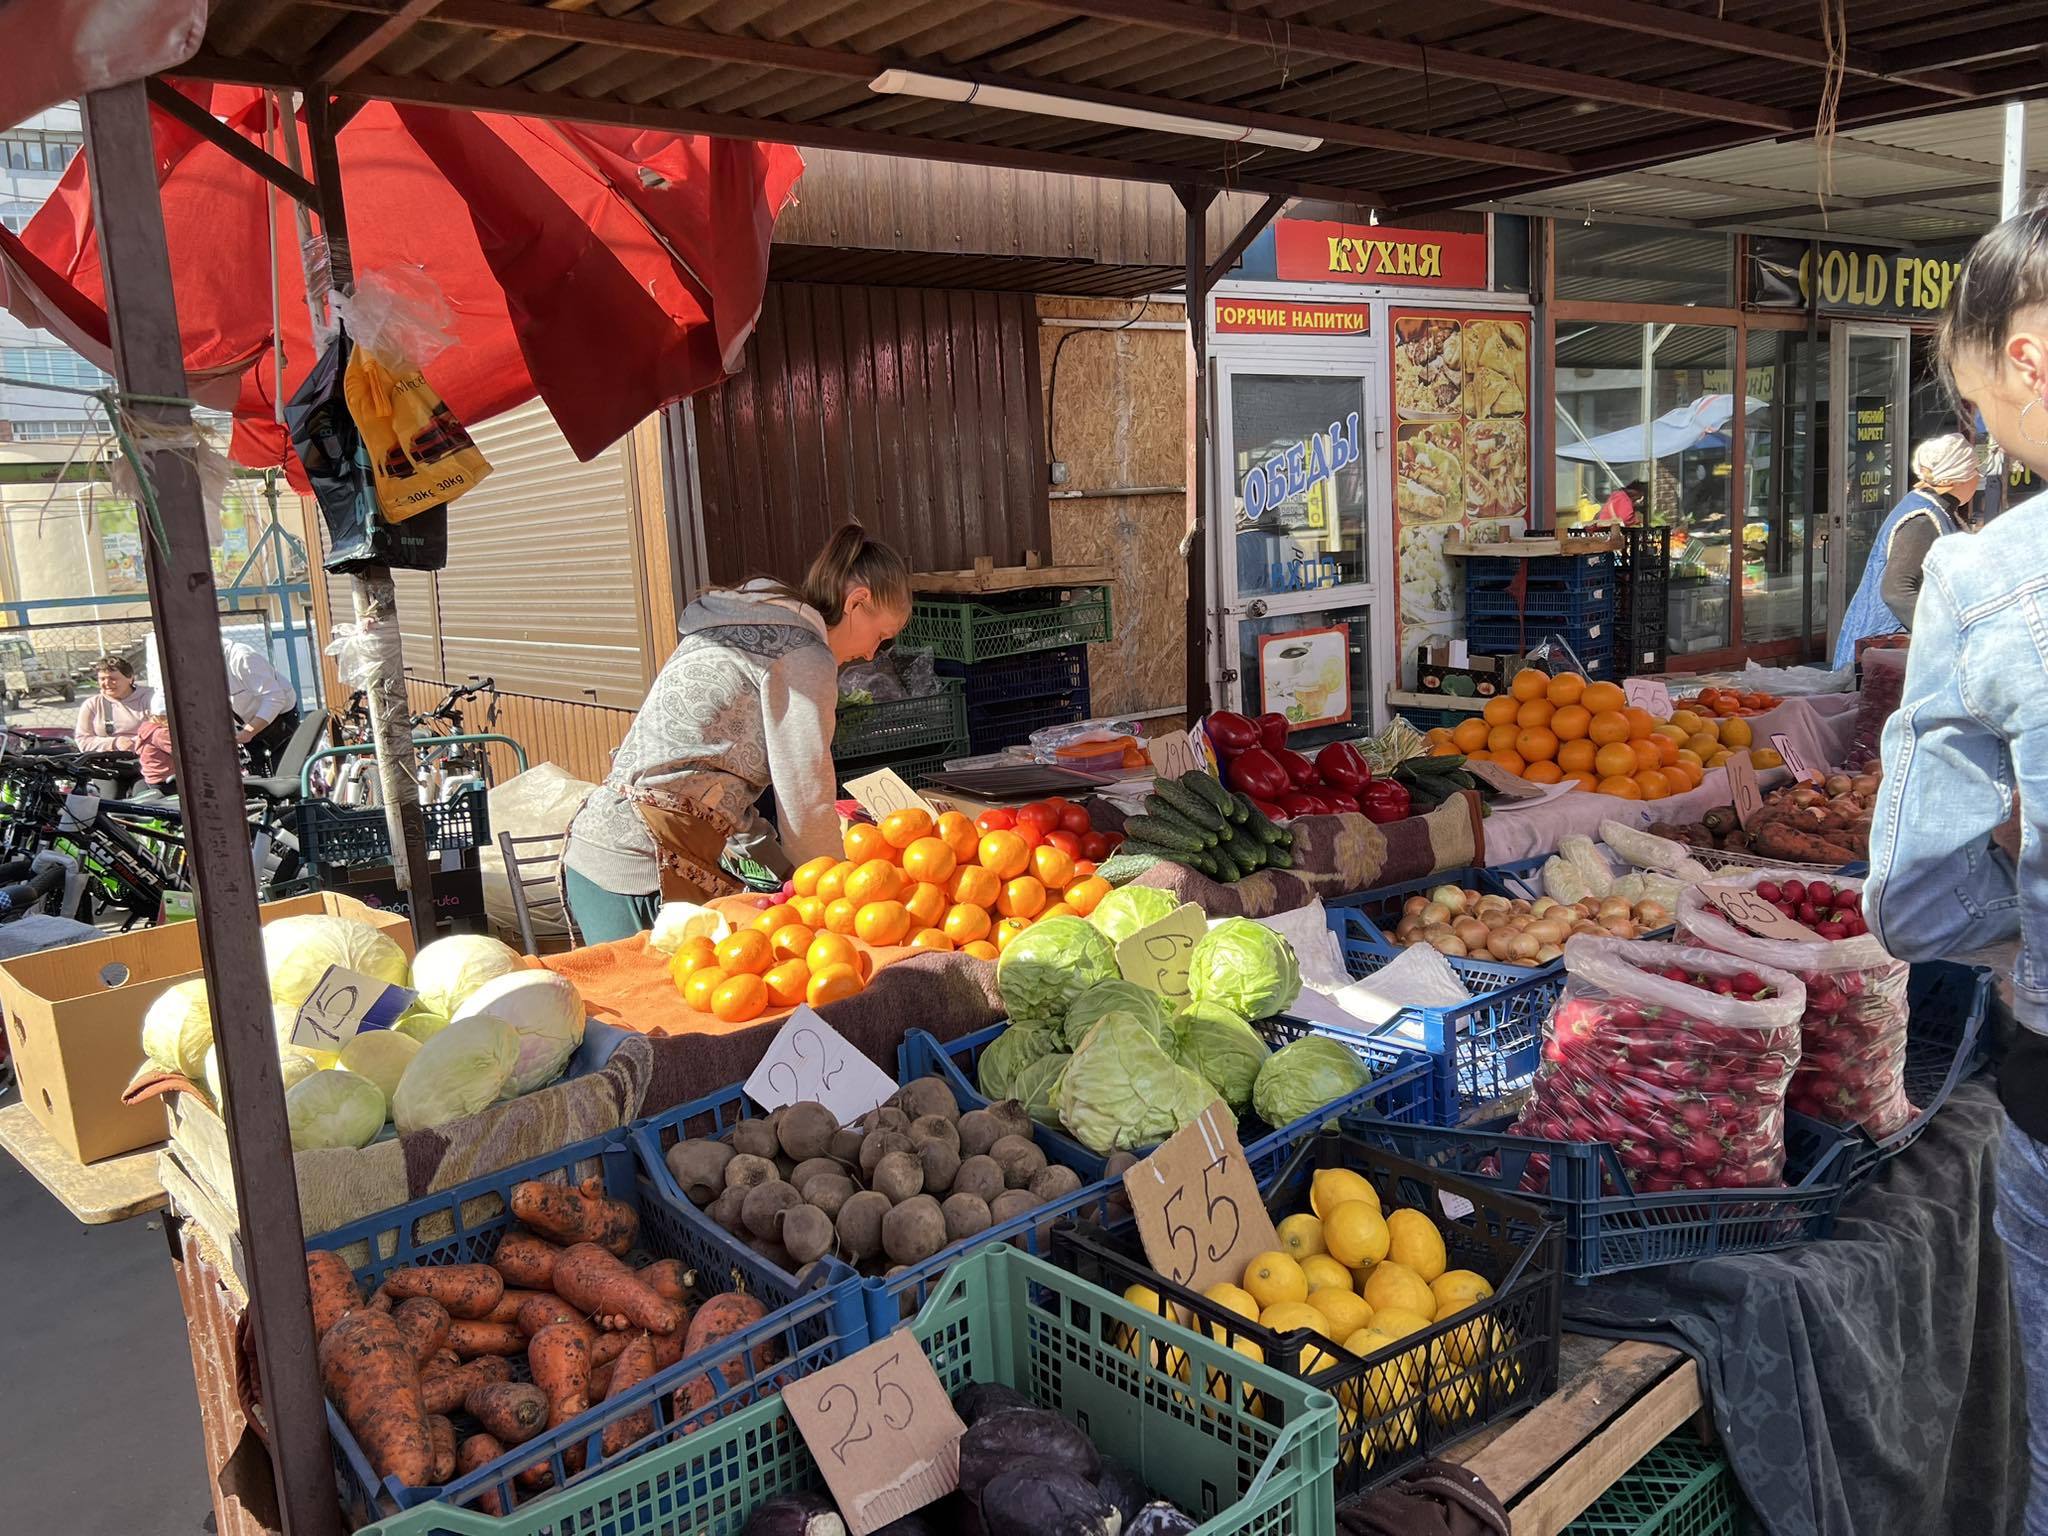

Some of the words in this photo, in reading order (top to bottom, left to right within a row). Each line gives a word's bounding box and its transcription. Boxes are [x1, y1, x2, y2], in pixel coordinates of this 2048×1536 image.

[1327, 236, 1442, 277] КУХНЯ
[1215, 306, 1286, 326] ГОРЯЧИЕ
[1292, 311, 1364, 329] НАПИТКИ
[1857, 427, 1884, 441] МАРКЕТ
[1244, 412, 1358, 519] ОБЕДЫ
[1860, 470, 1881, 486] GOLD
[436, 474, 465, 492] 30kg
[1861, 488, 1879, 503] FISH
[1271, 554, 1342, 594] ВХОД
[1719, 891, 1778, 924] 65
[1163, 1154, 1240, 1288] 55
[817, 1352, 914, 1466] 25
